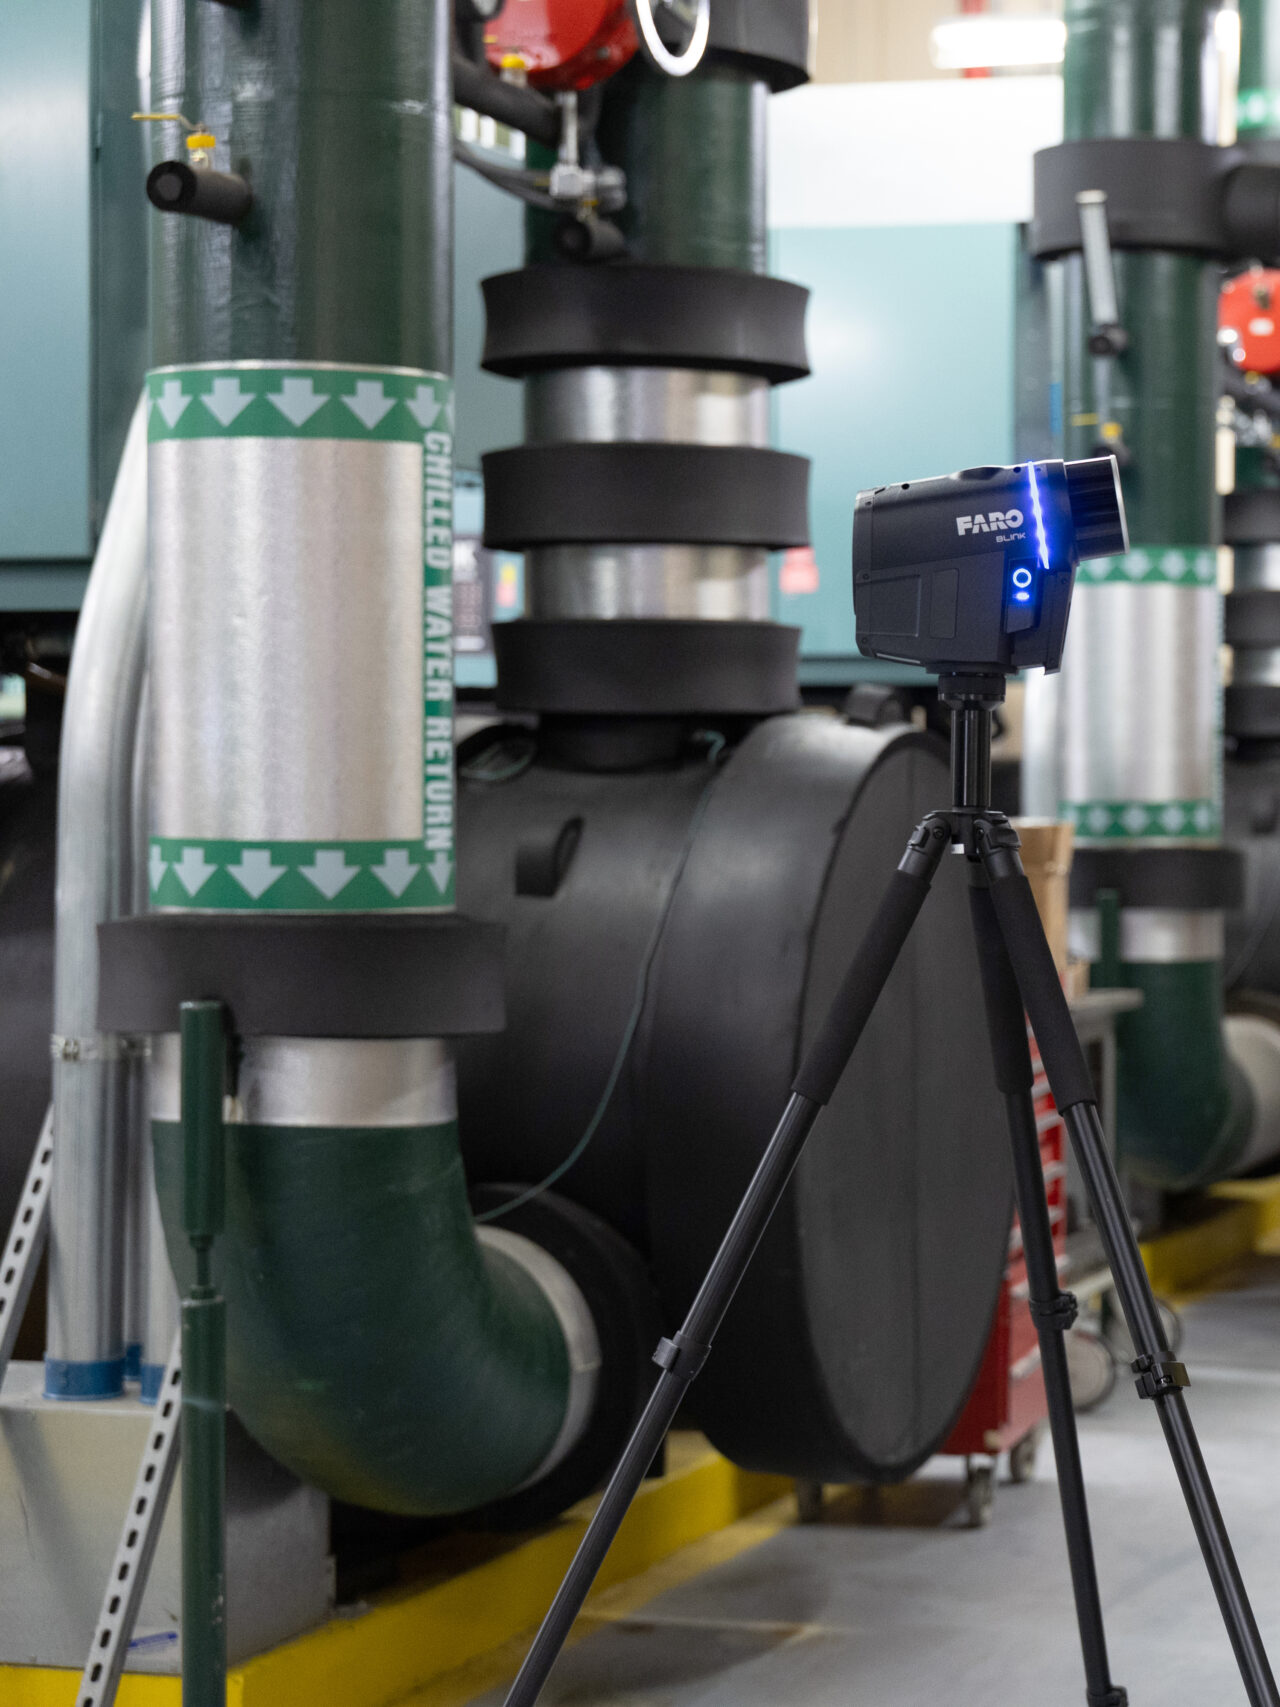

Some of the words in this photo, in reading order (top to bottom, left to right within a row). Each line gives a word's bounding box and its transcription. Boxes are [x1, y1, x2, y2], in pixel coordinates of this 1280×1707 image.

[424, 432, 453, 570] CHILLED
[956, 509, 1024, 536] FARO
[425, 586, 453, 701] WATER
[425, 716, 453, 851] RETURN
